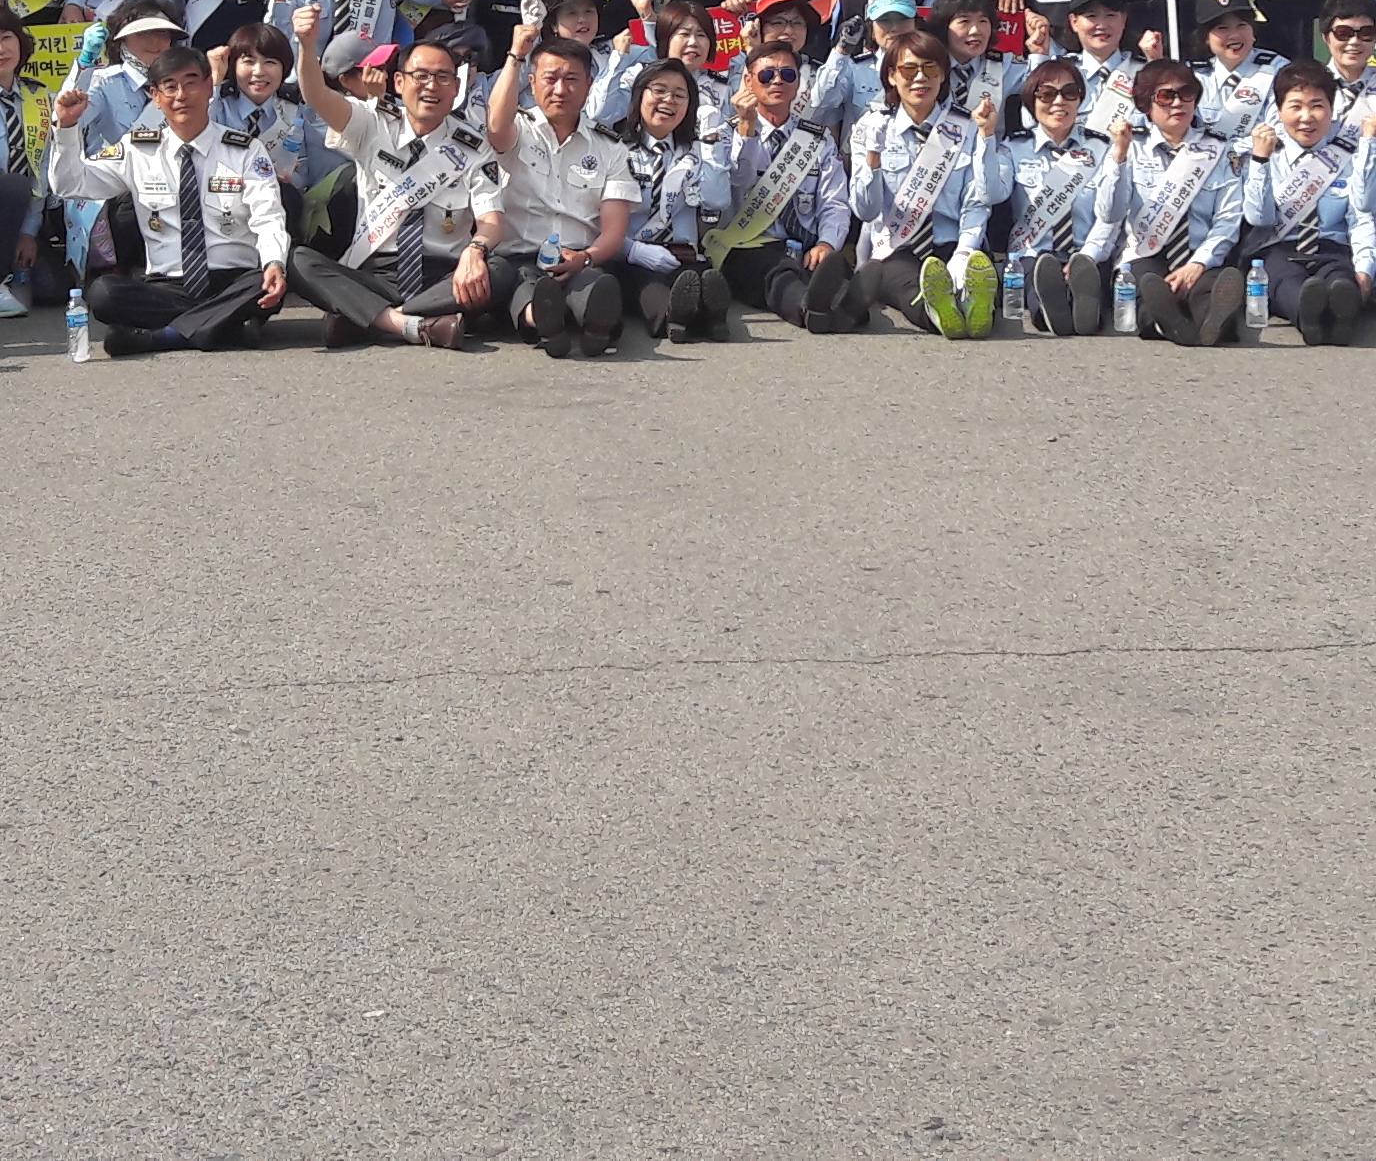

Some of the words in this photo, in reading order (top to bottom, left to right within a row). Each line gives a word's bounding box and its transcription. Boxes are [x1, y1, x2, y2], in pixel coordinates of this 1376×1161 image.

[402, 165, 450, 212] 최소한의
[921, 147, 957, 195] 최소한의
[1043, 170, 1085, 218] 음주운전
[1167, 164, 1207, 211] 최소한의
[894, 194, 930, 241] 안전소통
